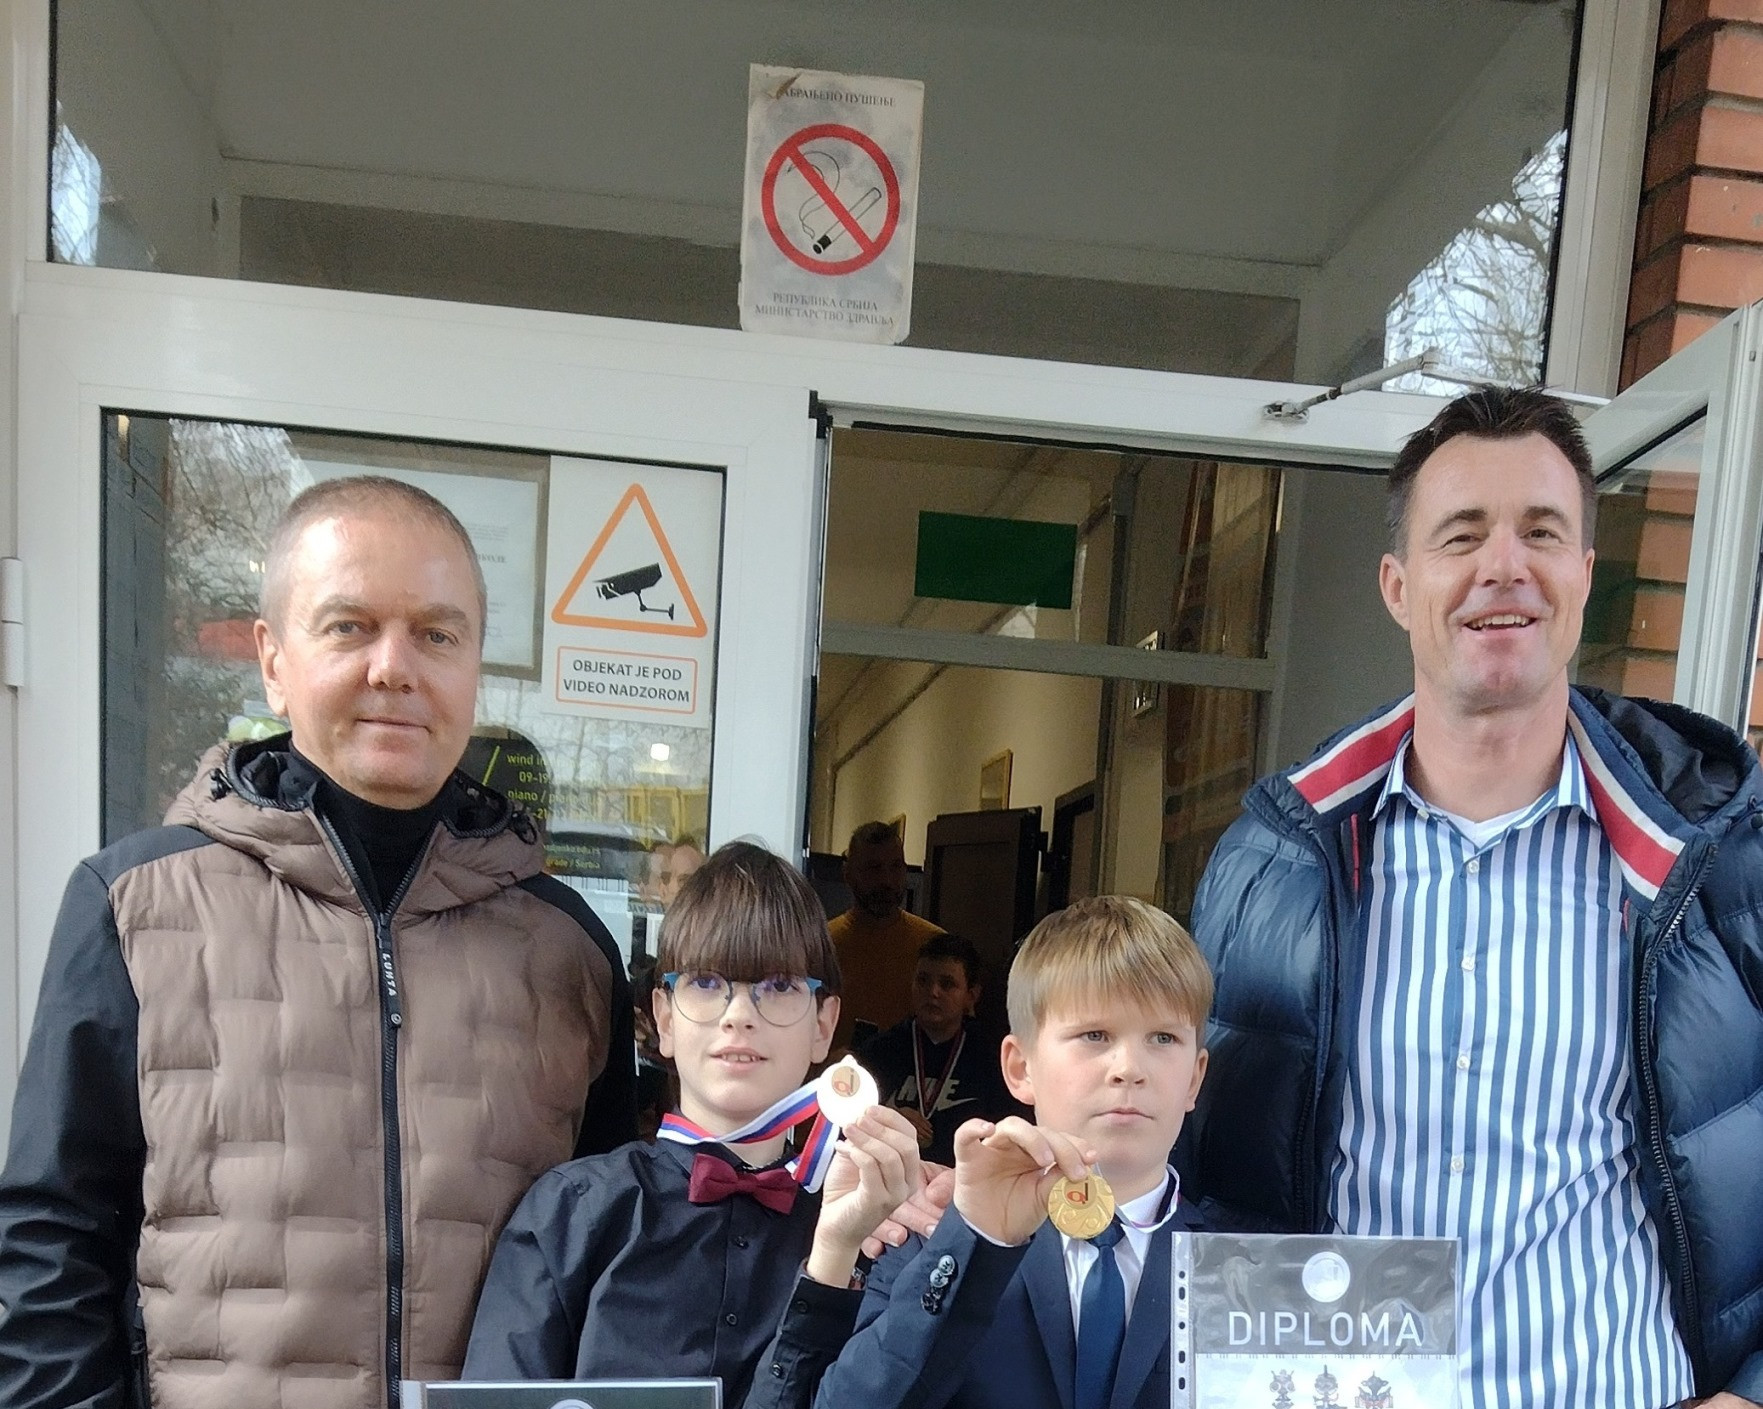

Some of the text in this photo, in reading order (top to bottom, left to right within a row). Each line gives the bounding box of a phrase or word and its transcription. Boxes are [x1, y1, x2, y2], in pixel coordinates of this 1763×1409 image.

[781, 87, 843, 102] АБРАЊЕНО
[773, 291, 836, 308] РЕПУБЛИКА
[572, 659, 682, 682] OBJEKAT JE POD
[563, 679, 690, 703] VIDEO NADZOROM
[507, 753, 534, 765] wind
[1228, 1311, 1423, 1347] DIPLOMA
